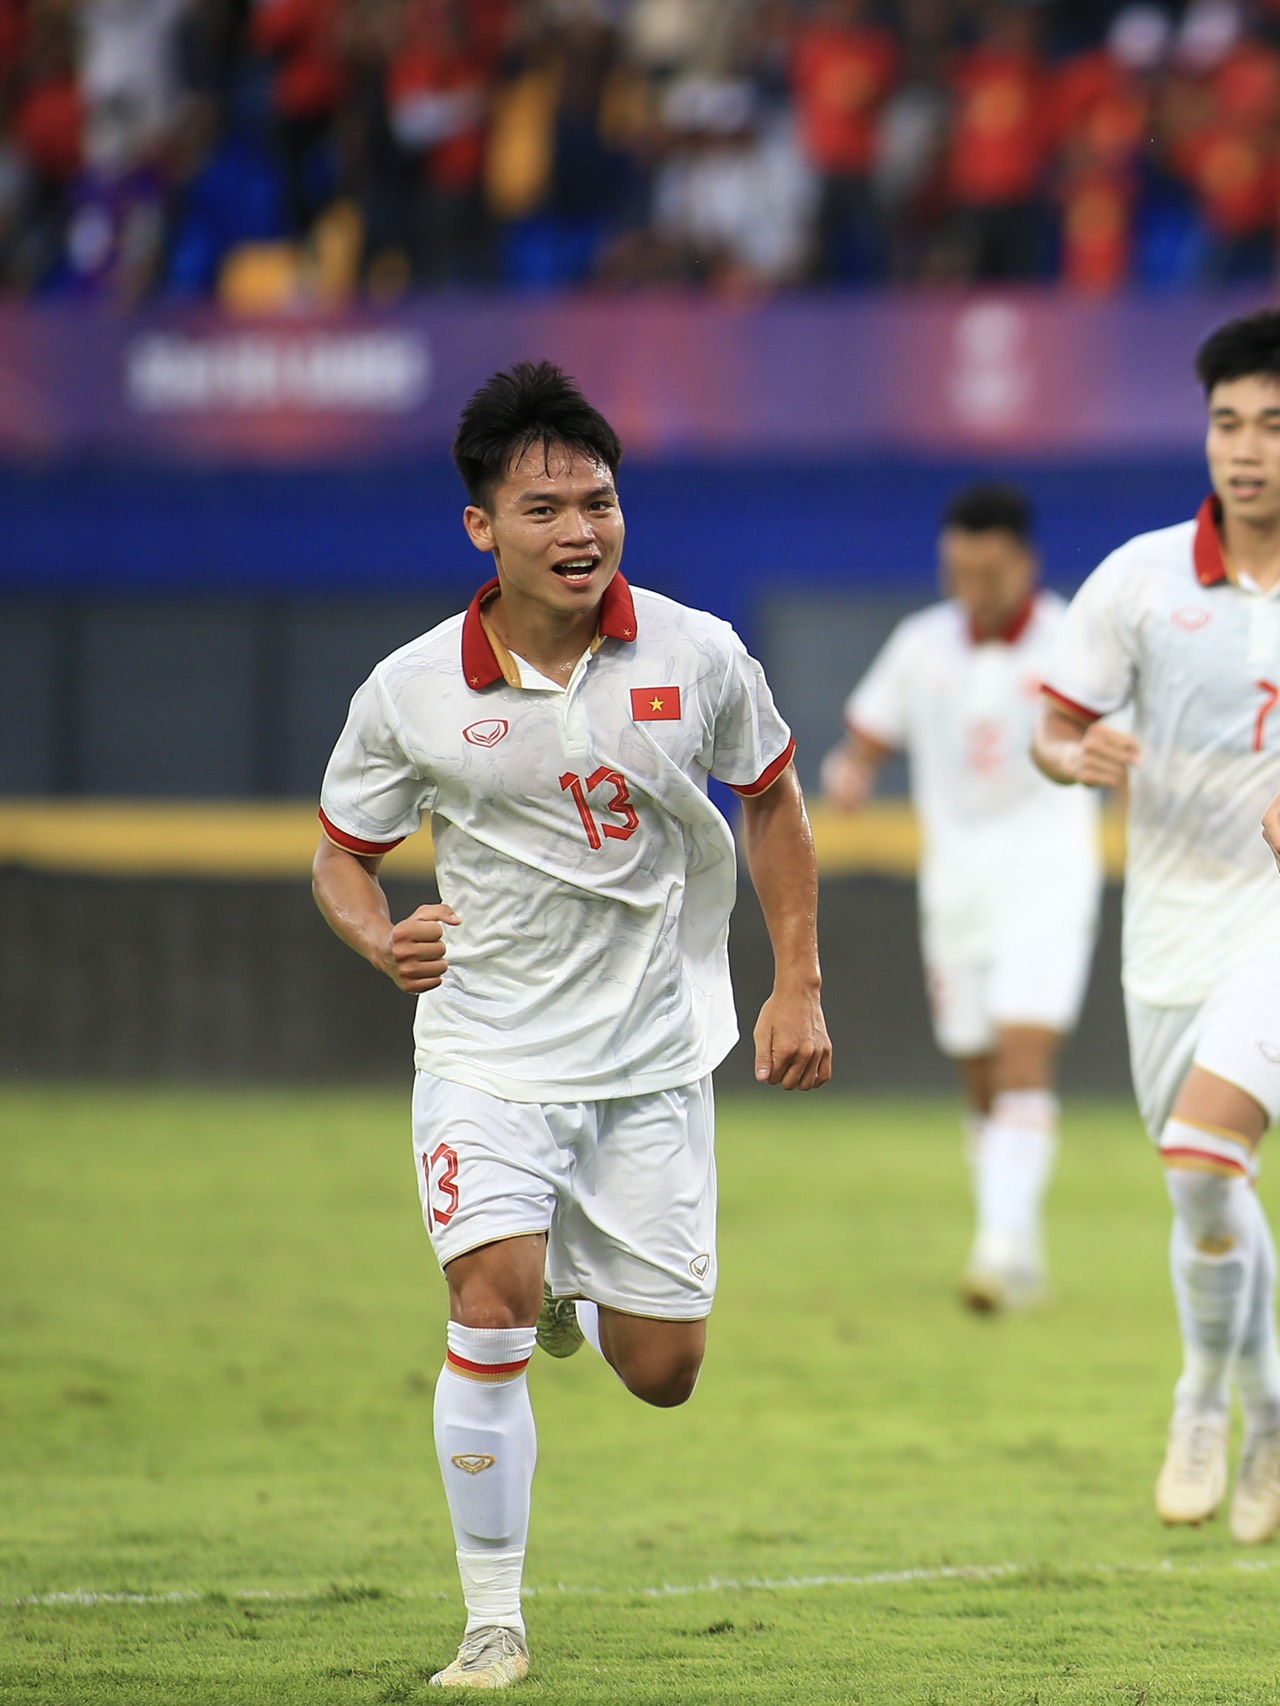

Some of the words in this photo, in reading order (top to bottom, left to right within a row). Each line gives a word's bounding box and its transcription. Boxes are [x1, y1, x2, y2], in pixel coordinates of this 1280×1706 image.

[1253, 680, 1280, 753] 7
[558, 765, 640, 850] 13
[422, 1143, 459, 1233] 13
